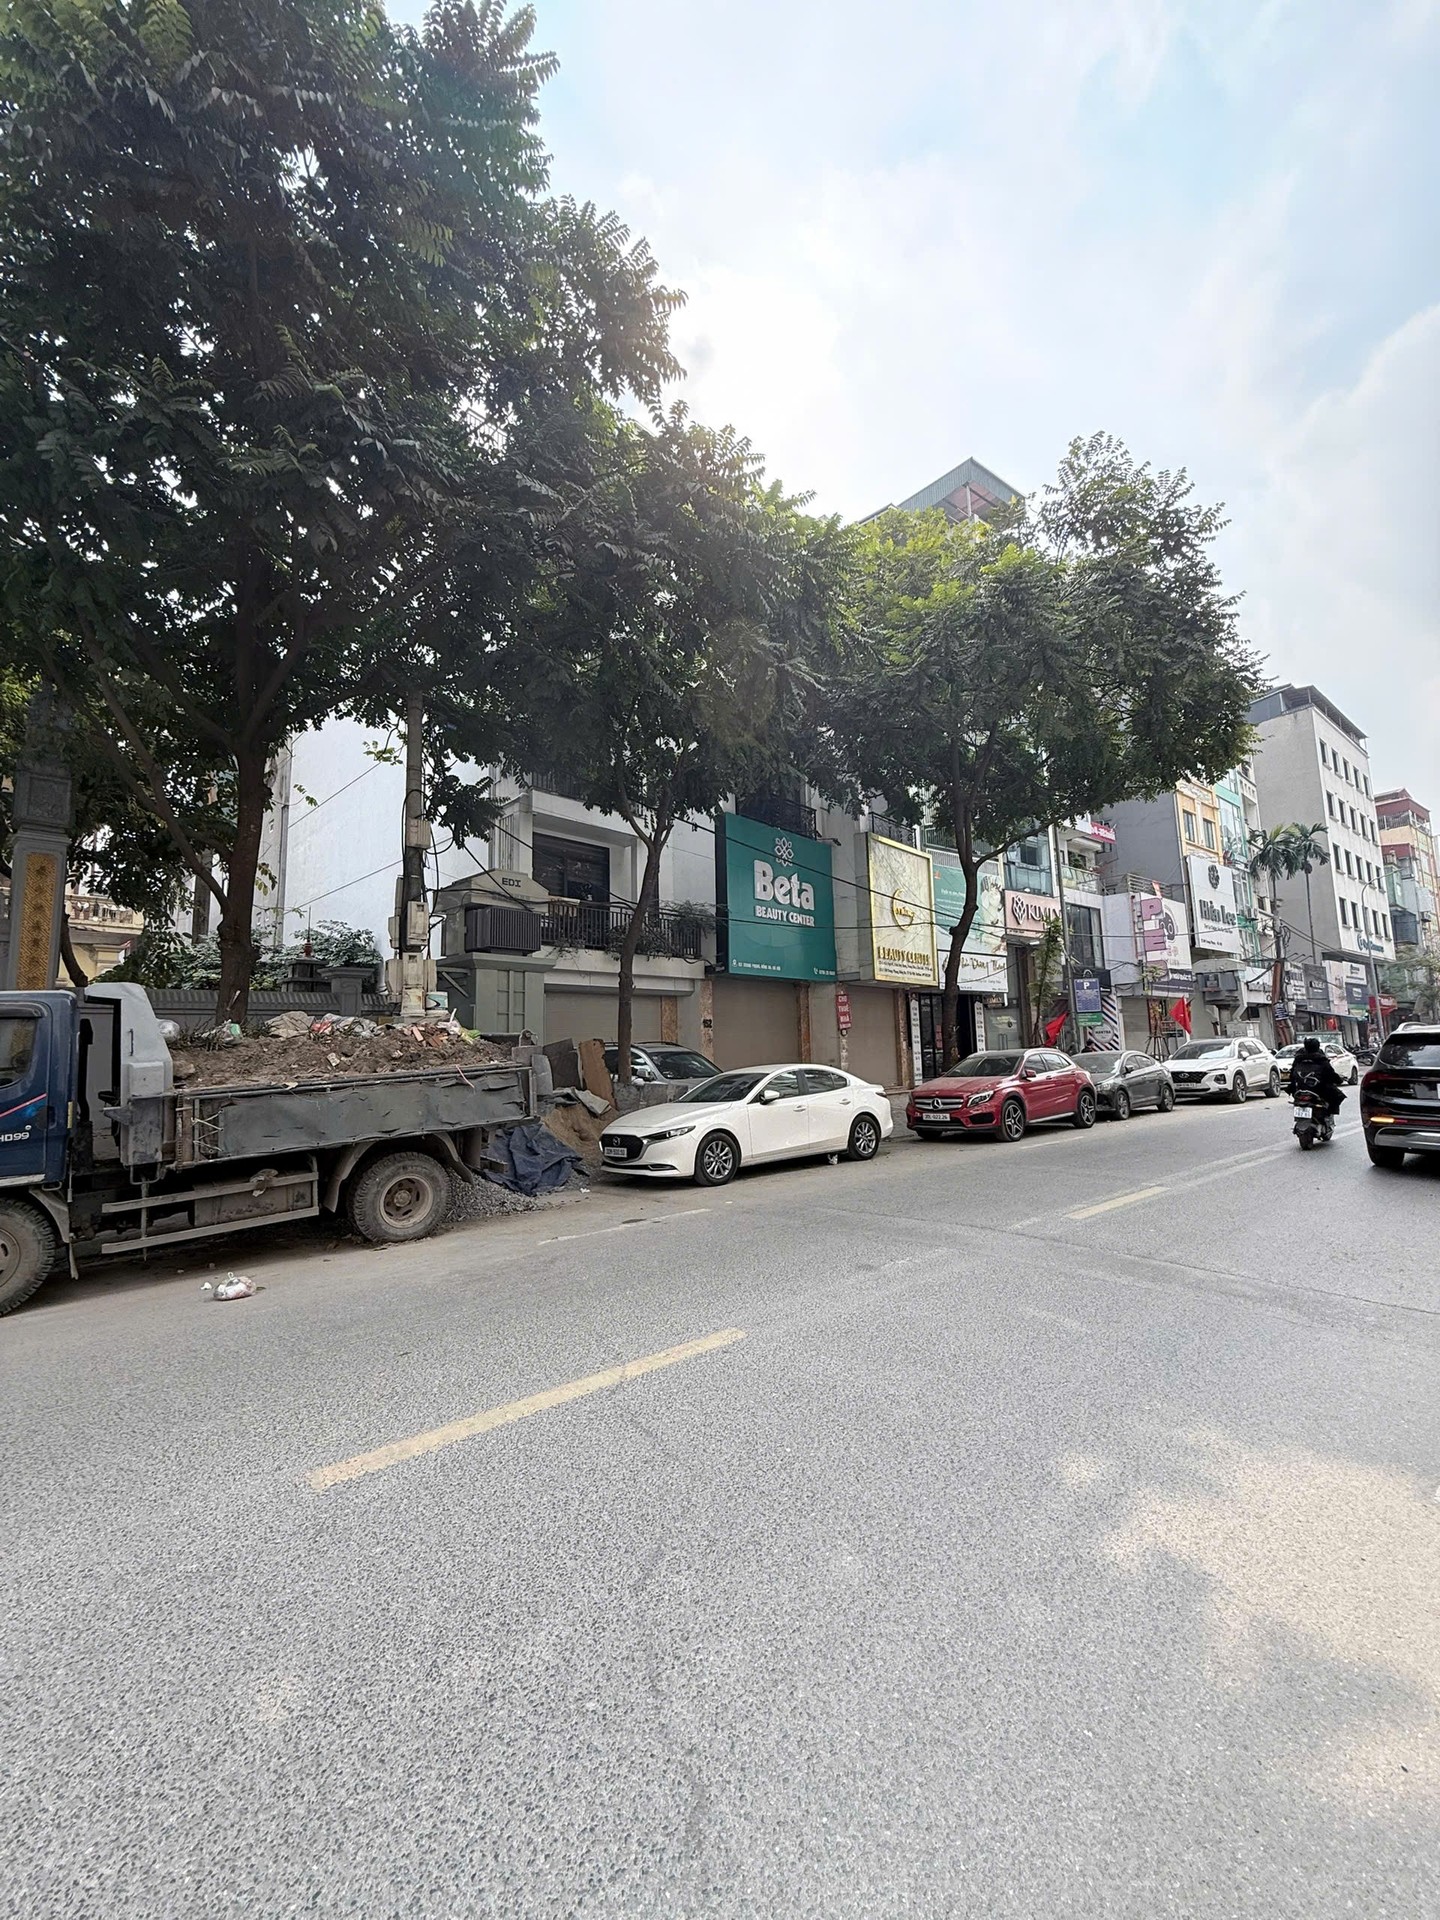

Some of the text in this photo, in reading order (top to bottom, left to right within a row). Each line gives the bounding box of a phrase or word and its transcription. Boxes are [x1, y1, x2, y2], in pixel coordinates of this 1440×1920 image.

[502, 877, 521, 887] EDI
[754, 860, 814, 910] Beta
[755, 905, 814, 927] BEAUTY CENTER
[1221, 905, 1236, 925] Lee
[1083, 982, 1090, 990] P
